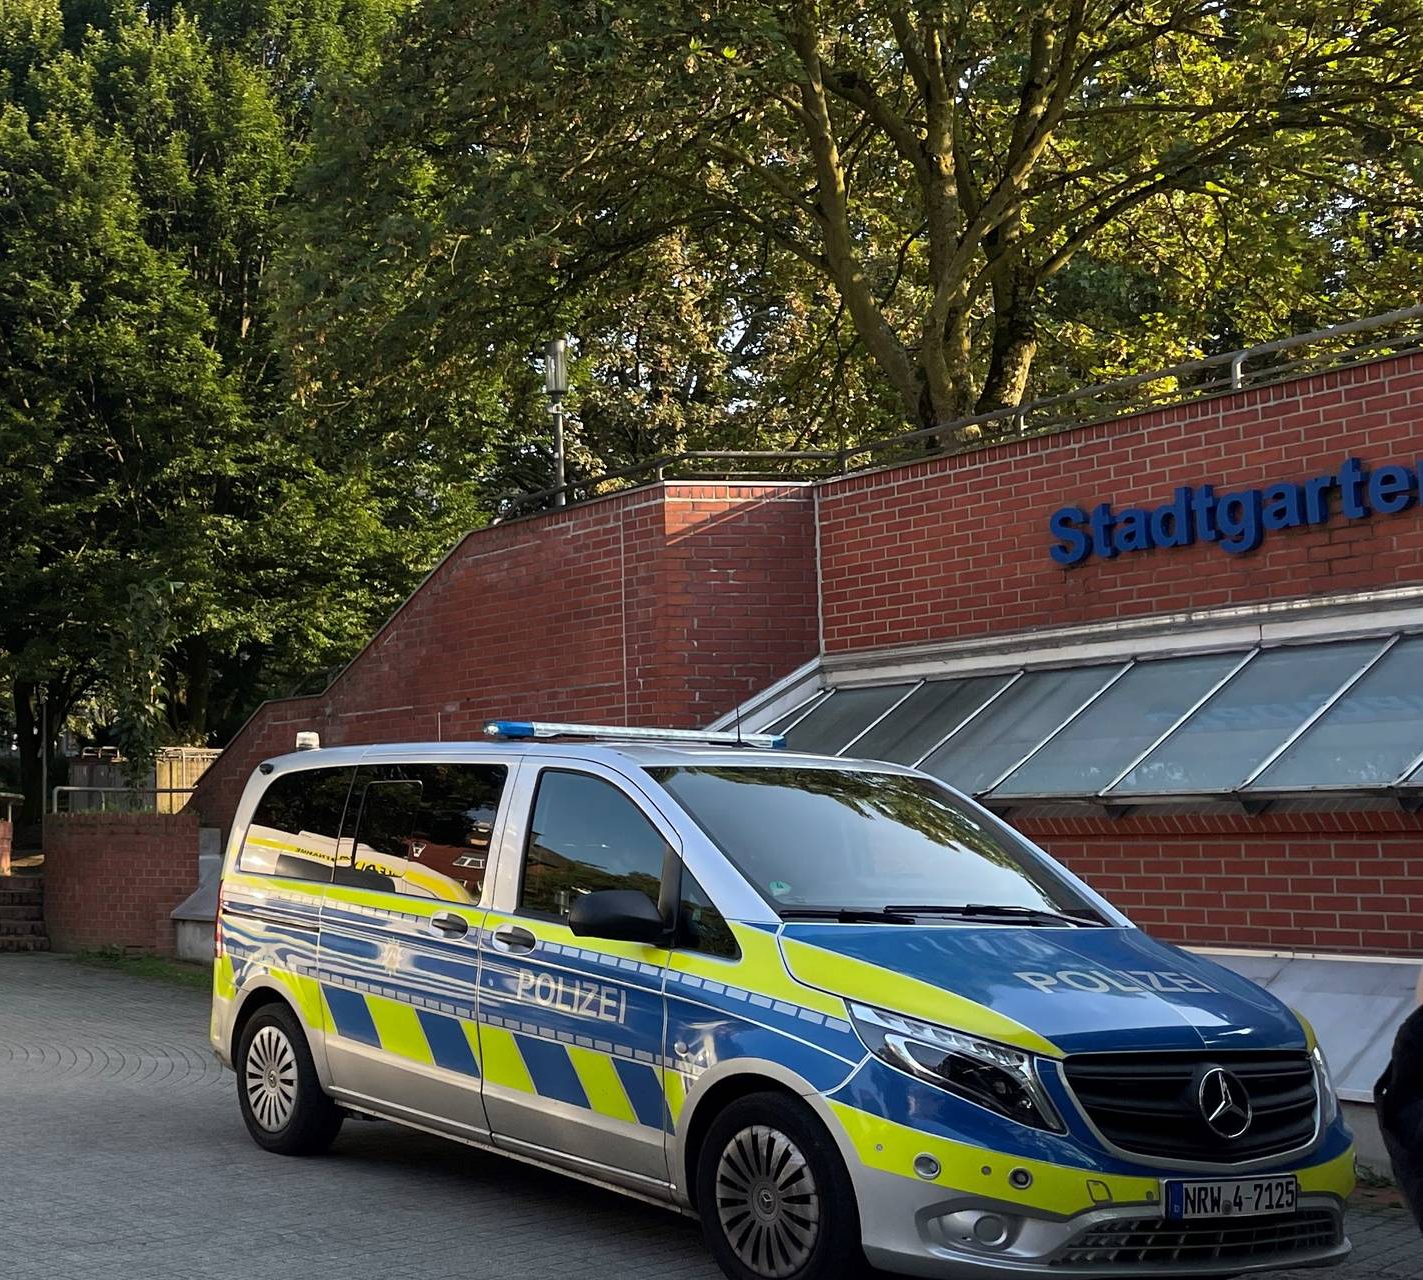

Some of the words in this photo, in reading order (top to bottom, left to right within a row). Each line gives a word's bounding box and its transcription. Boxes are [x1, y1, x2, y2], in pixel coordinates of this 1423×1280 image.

[1048, 457, 1423, 565] Stadtgarte
[516, 967, 627, 1025] POLIZEI
[1011, 969, 1220, 994] POLIZEI
[1184, 1185, 1222, 1215] NRW
[1233, 1180, 1295, 1212] 4-7125
